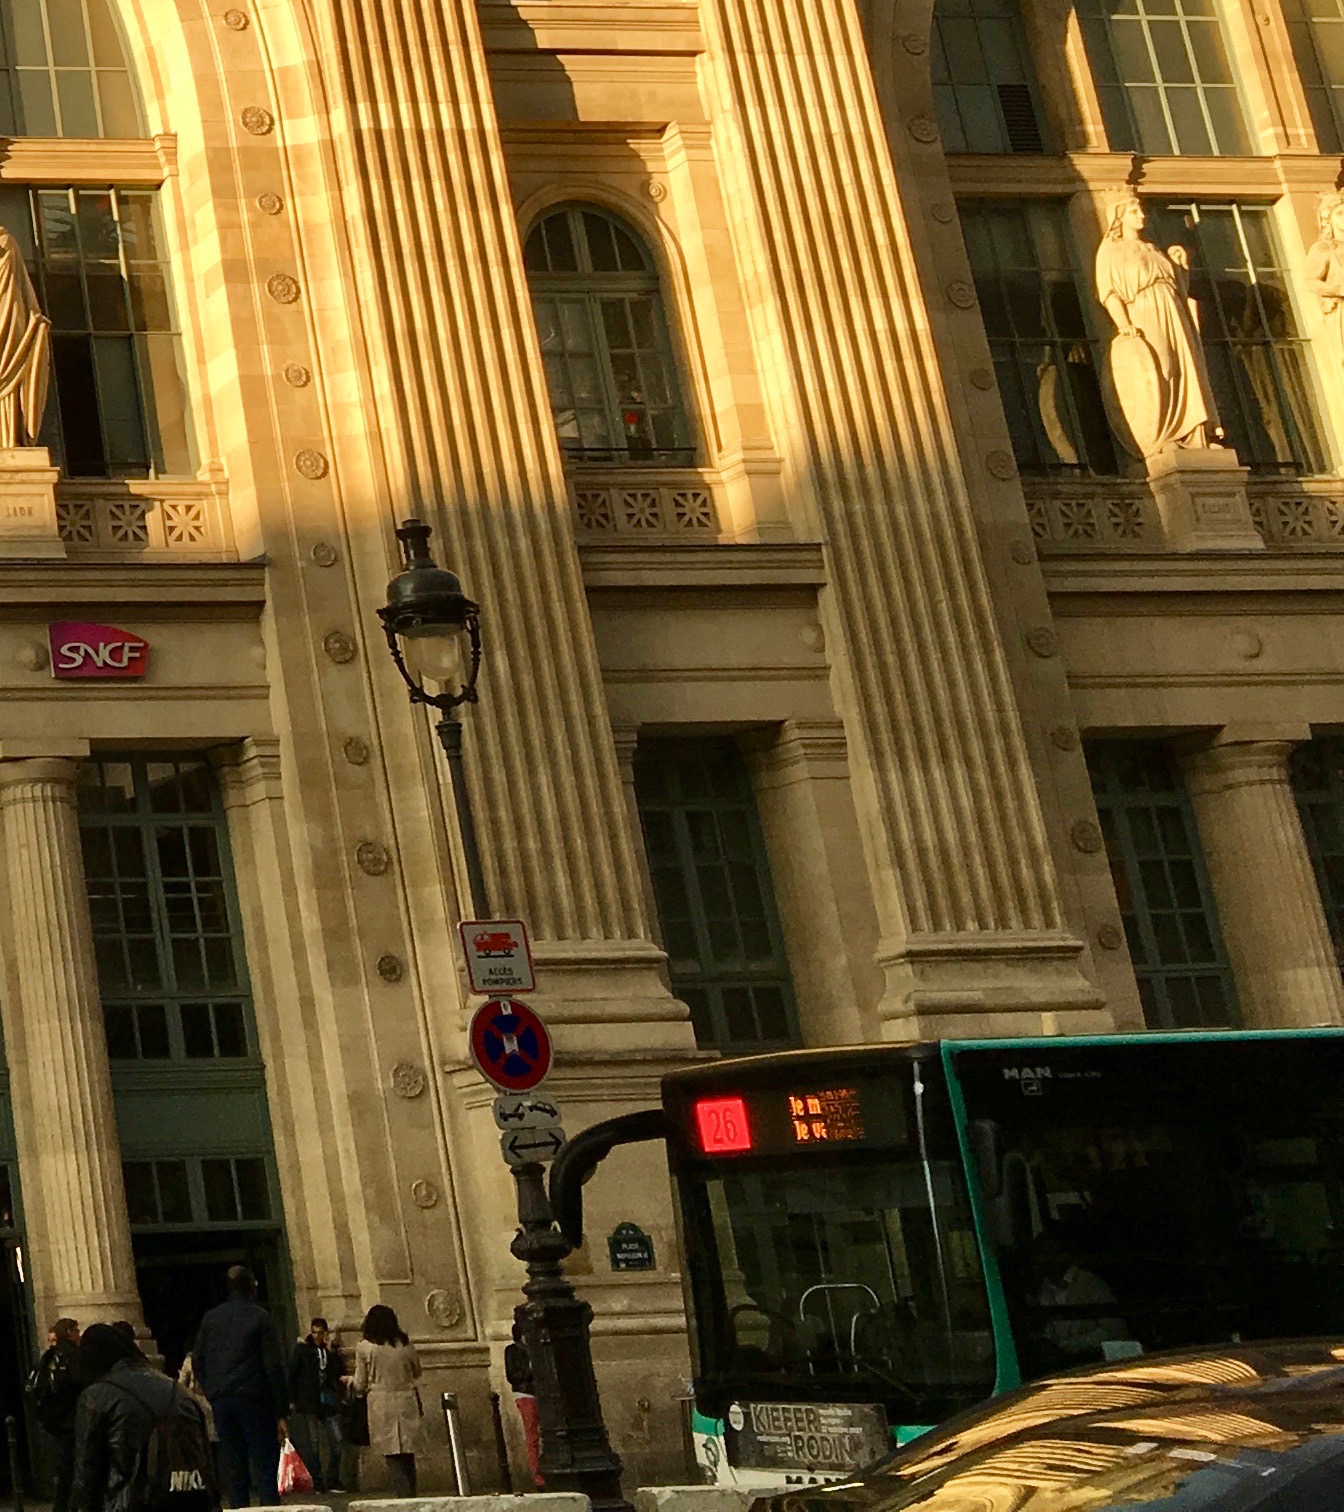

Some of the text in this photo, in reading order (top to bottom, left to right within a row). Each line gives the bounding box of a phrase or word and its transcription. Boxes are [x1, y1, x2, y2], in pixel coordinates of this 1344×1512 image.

[58, 642, 144, 668] SNCF
[1002, 1067, 1052, 1079] MAN
[708, 1106, 738, 1145] 26
[750, 1404, 823, 1434] KIEFER
[791, 1431, 858, 1464] RODIN
